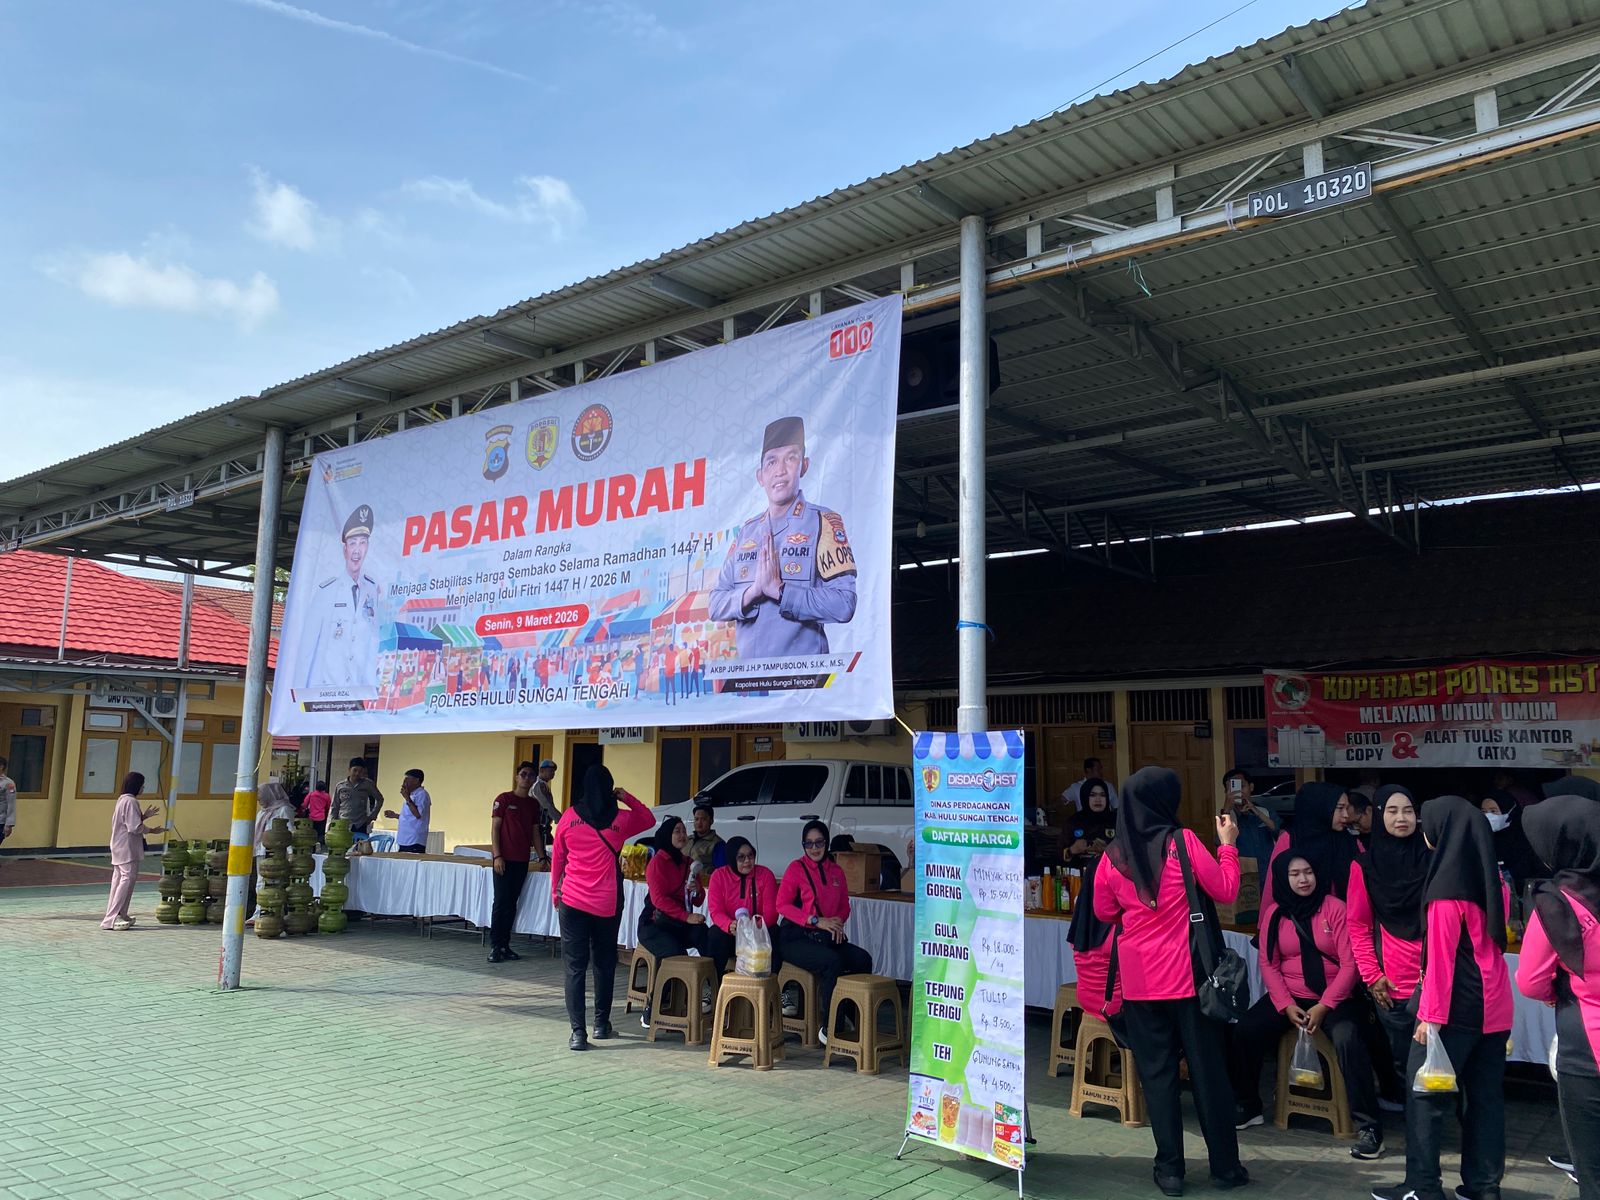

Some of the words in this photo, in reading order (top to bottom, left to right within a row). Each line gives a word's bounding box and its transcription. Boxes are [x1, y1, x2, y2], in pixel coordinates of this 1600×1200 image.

[1253, 192, 1288, 216] POL
[1303, 171, 1366, 204] 10320
[832, 325, 872, 354] 110
[402, 495, 528, 556] PASAR
[535, 457, 706, 534] MURAH
[503, 549, 532, 561] Dalam
[534, 542, 572, 557] Rangka
[737, 551, 758, 562] JUPRI
[781, 547, 810, 557] POLRI
[390, 582, 427, 597] Menjaga
[430, 575, 473, 589] Stabilitas
[476, 570, 505, 584] Harga
[508, 563, 556, 579] Sembako
[559, 557, 599, 571] Selama
[603, 546, 666, 565] Ramadhan
[671, 540, 700, 556] 1447
[703, 537, 713, 551] H
[819, 550, 836, 573] KA
[446, 590, 495, 607] Menjelang
[498, 586, 517, 600] Idul
[520, 582, 541, 597] Fitri
[544, 578, 569, 594] 1447
[572, 577, 581, 590] H
[583, 576, 588, 588] /
[590, 572, 617, 588] 2026
[620, 570, 631, 584] M
[484, 618, 514, 631] Senin,
[516, 616, 522, 627] 9
[525, 614, 552, 627] Maret
[555, 610, 578, 623] 2026
[710, 666, 727, 674] AKBP
[727, 665, 745, 673] JUPRI
[735, 681, 759, 690] Kapolres
[759, 680, 772, 688] Hulu
[772, 679, 793, 689] Sungai
[793, 678, 815, 688] Tengah
[1322, 669, 1438, 700] KOPERASI
[1447, 665, 1539, 695] POLRES
[1545, 662, 1599, 693] HST
[430, 692, 477, 708] POLRES
[480, 689, 514, 706] HULU
[518, 687, 568, 704] SUNGAI
[572, 683, 630, 700] TENGAH
[1359, 703, 1436, 724] MELAYANI
[1441, 702, 1494, 722] UNTUK
[1502, 701, 1558, 721] UMUM
[1345, 731, 1381, 745] FOTO
[1423, 729, 1461, 744] ALAT
[1463, 728, 1504, 744] TULIS
[1508, 729, 1574, 744] KANTOR
[1391, 731, 1420, 760] &
[1478, 745, 1517, 760] (ATK)
[1345, 747, 1384, 762] COPY
[948, 774, 983, 786] DISDAG
[994, 774, 1017, 786] HST
[931, 800, 952, 809] DINAS
[953, 801, 1011, 811] PERDAGANGAN
[938, 812, 958, 821] HULU
[958, 813, 986, 822] SUNGAI
[987, 814, 1019, 823] TENGAH
[931, 829, 969, 844] DAFTAR
[971, 832, 1013, 846] HARGA
[925, 863, 962, 881] MINYAK
[926, 883, 962, 900] GORENG
[934, 922, 958, 939] GULA
[921, 941, 969, 960] TIMBANG
[925, 982, 964, 1001] TEPUNG
[980, 988, 1008, 1004] TULIP
[927, 1002, 962, 1021] TERIGU
[933, 1043, 951, 1060] TEH
